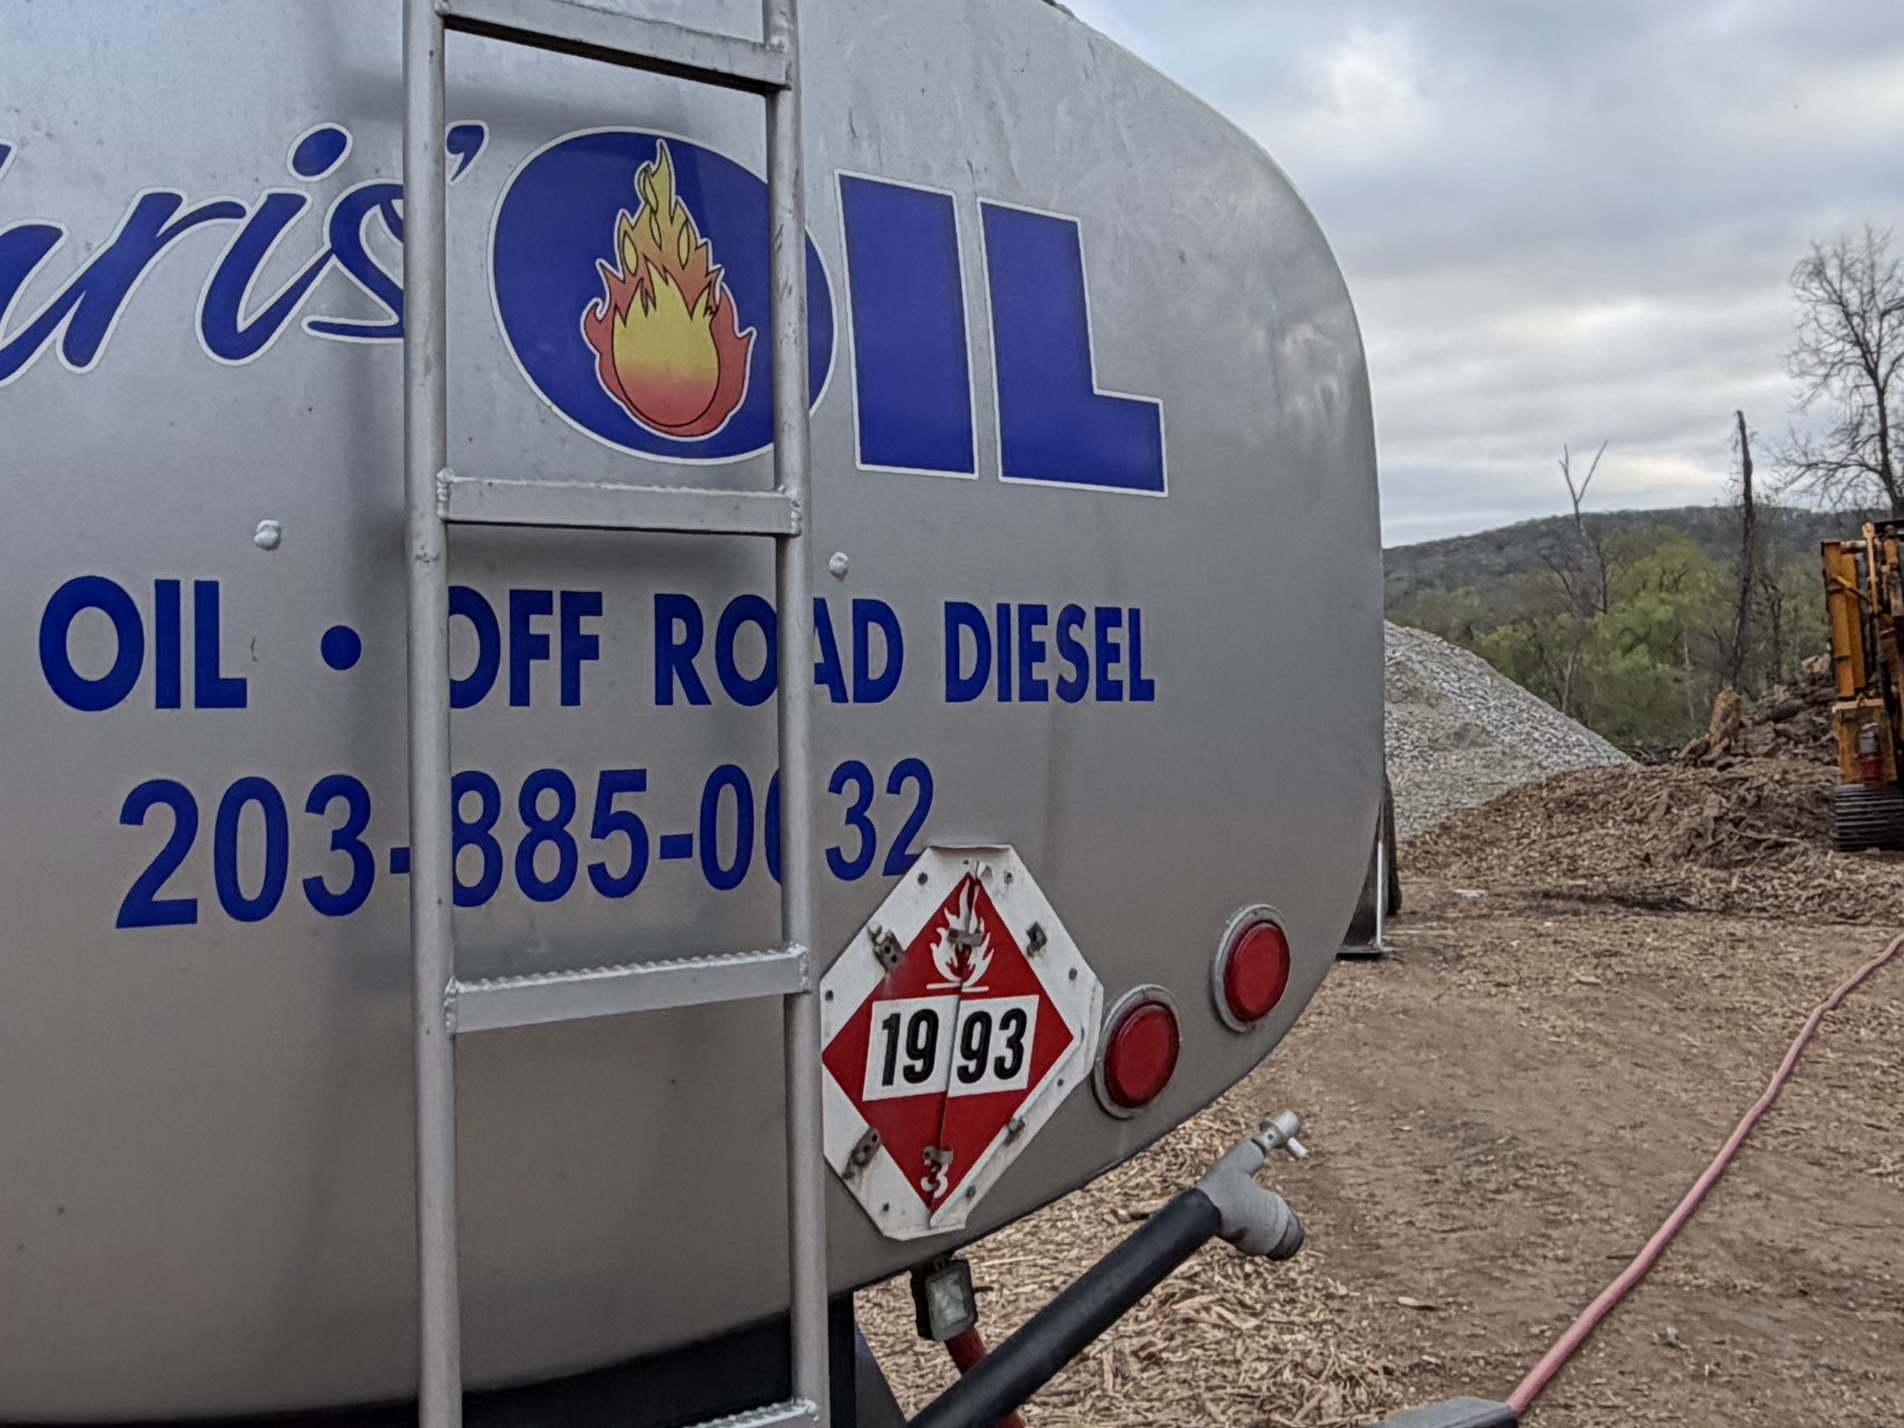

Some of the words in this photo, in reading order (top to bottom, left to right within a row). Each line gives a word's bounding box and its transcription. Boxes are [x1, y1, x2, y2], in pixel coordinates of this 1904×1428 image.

[488, 125, 1169, 498] OIL
[38, 574, 248, 713] OIL
[447, 585, 604, 710] OFF
[943, 601, 1156, 705] DIESEL
[879, 1007, 1028, 1088] 1993
